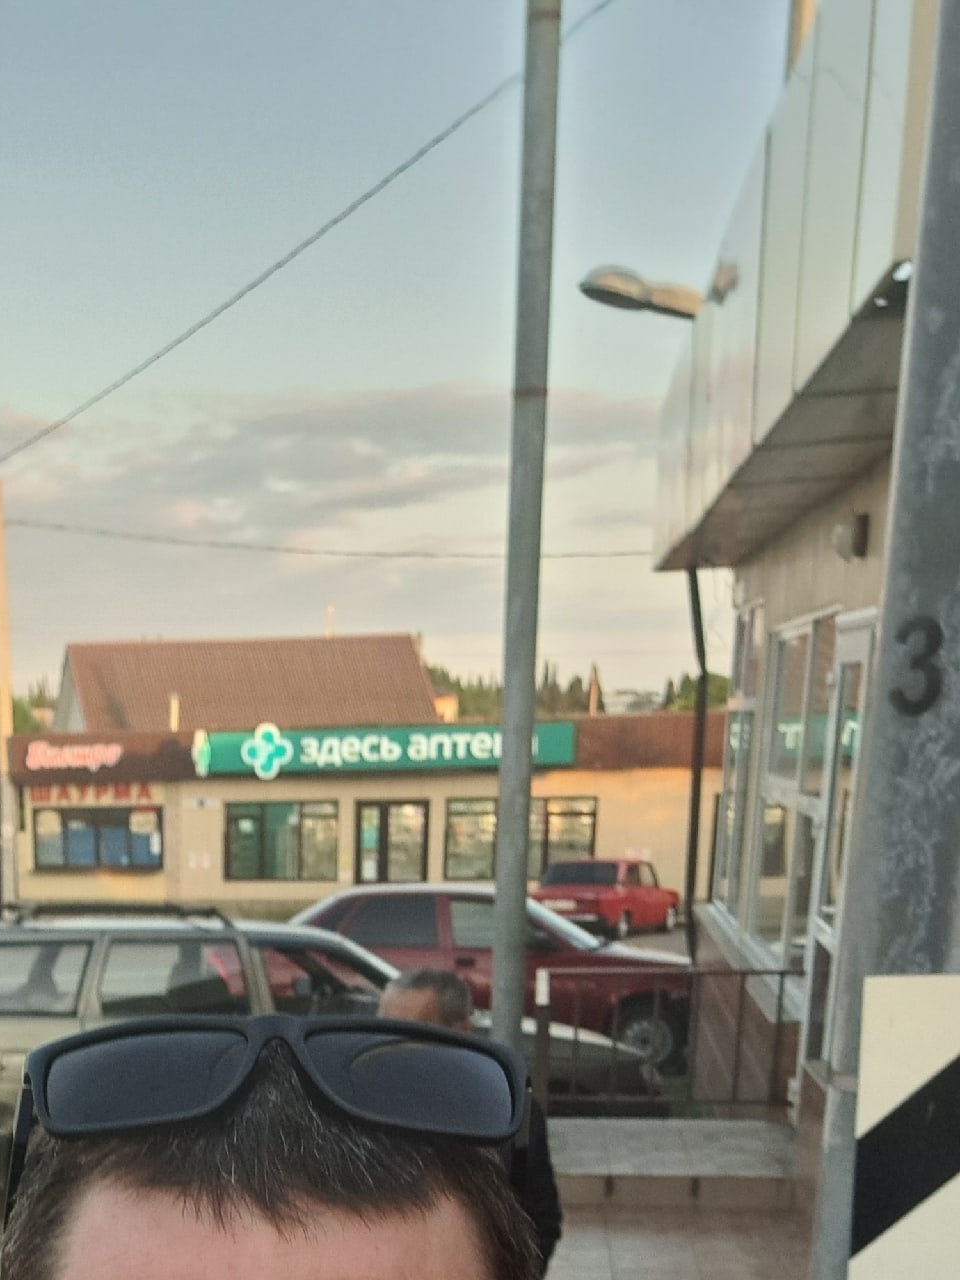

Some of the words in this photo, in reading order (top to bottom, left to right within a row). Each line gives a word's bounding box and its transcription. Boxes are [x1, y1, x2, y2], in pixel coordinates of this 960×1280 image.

[888, 616, 943, 718] 3
[300, 735, 402, 768] здесь
[407, 731, 538, 762] апте
[32, 782, 151, 801] ШАУРМА
